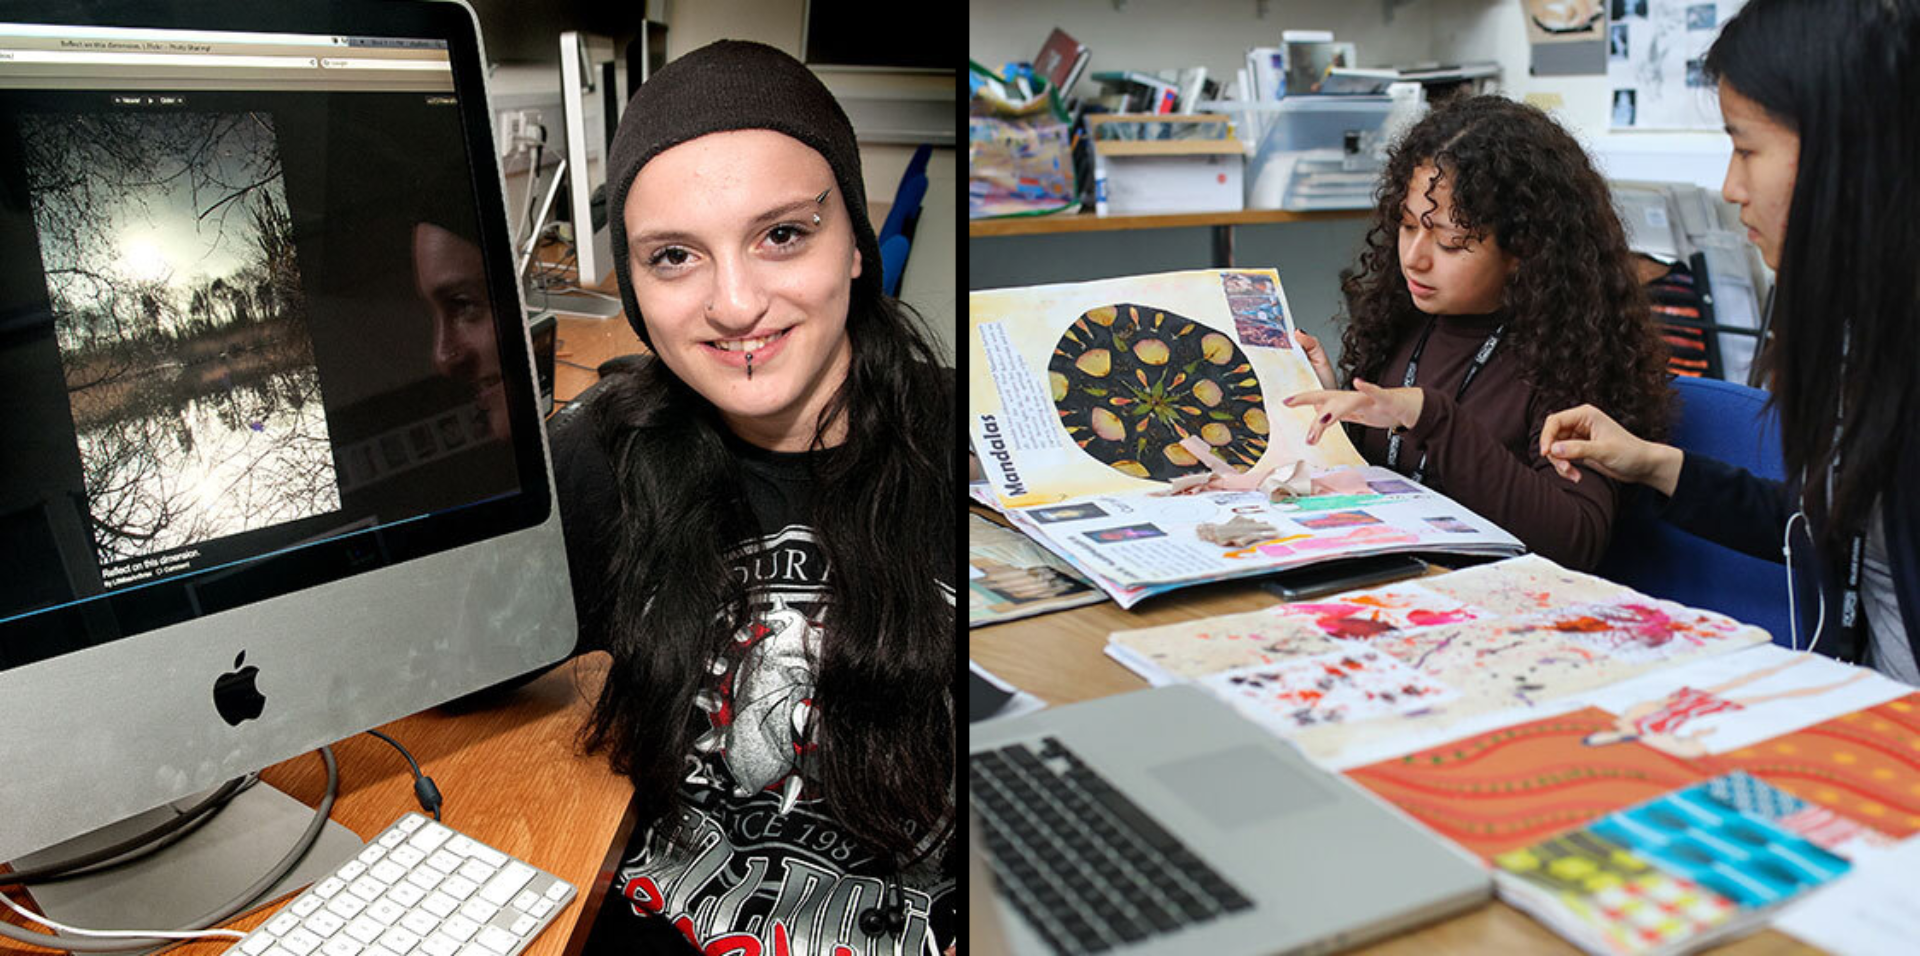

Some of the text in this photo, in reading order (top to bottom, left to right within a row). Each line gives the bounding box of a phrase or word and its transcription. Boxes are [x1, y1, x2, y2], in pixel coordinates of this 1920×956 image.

[980, 414, 1028, 497] Mandalas
[102, 564, 131, 578] Reflect
[132, 562, 143, 571] on
